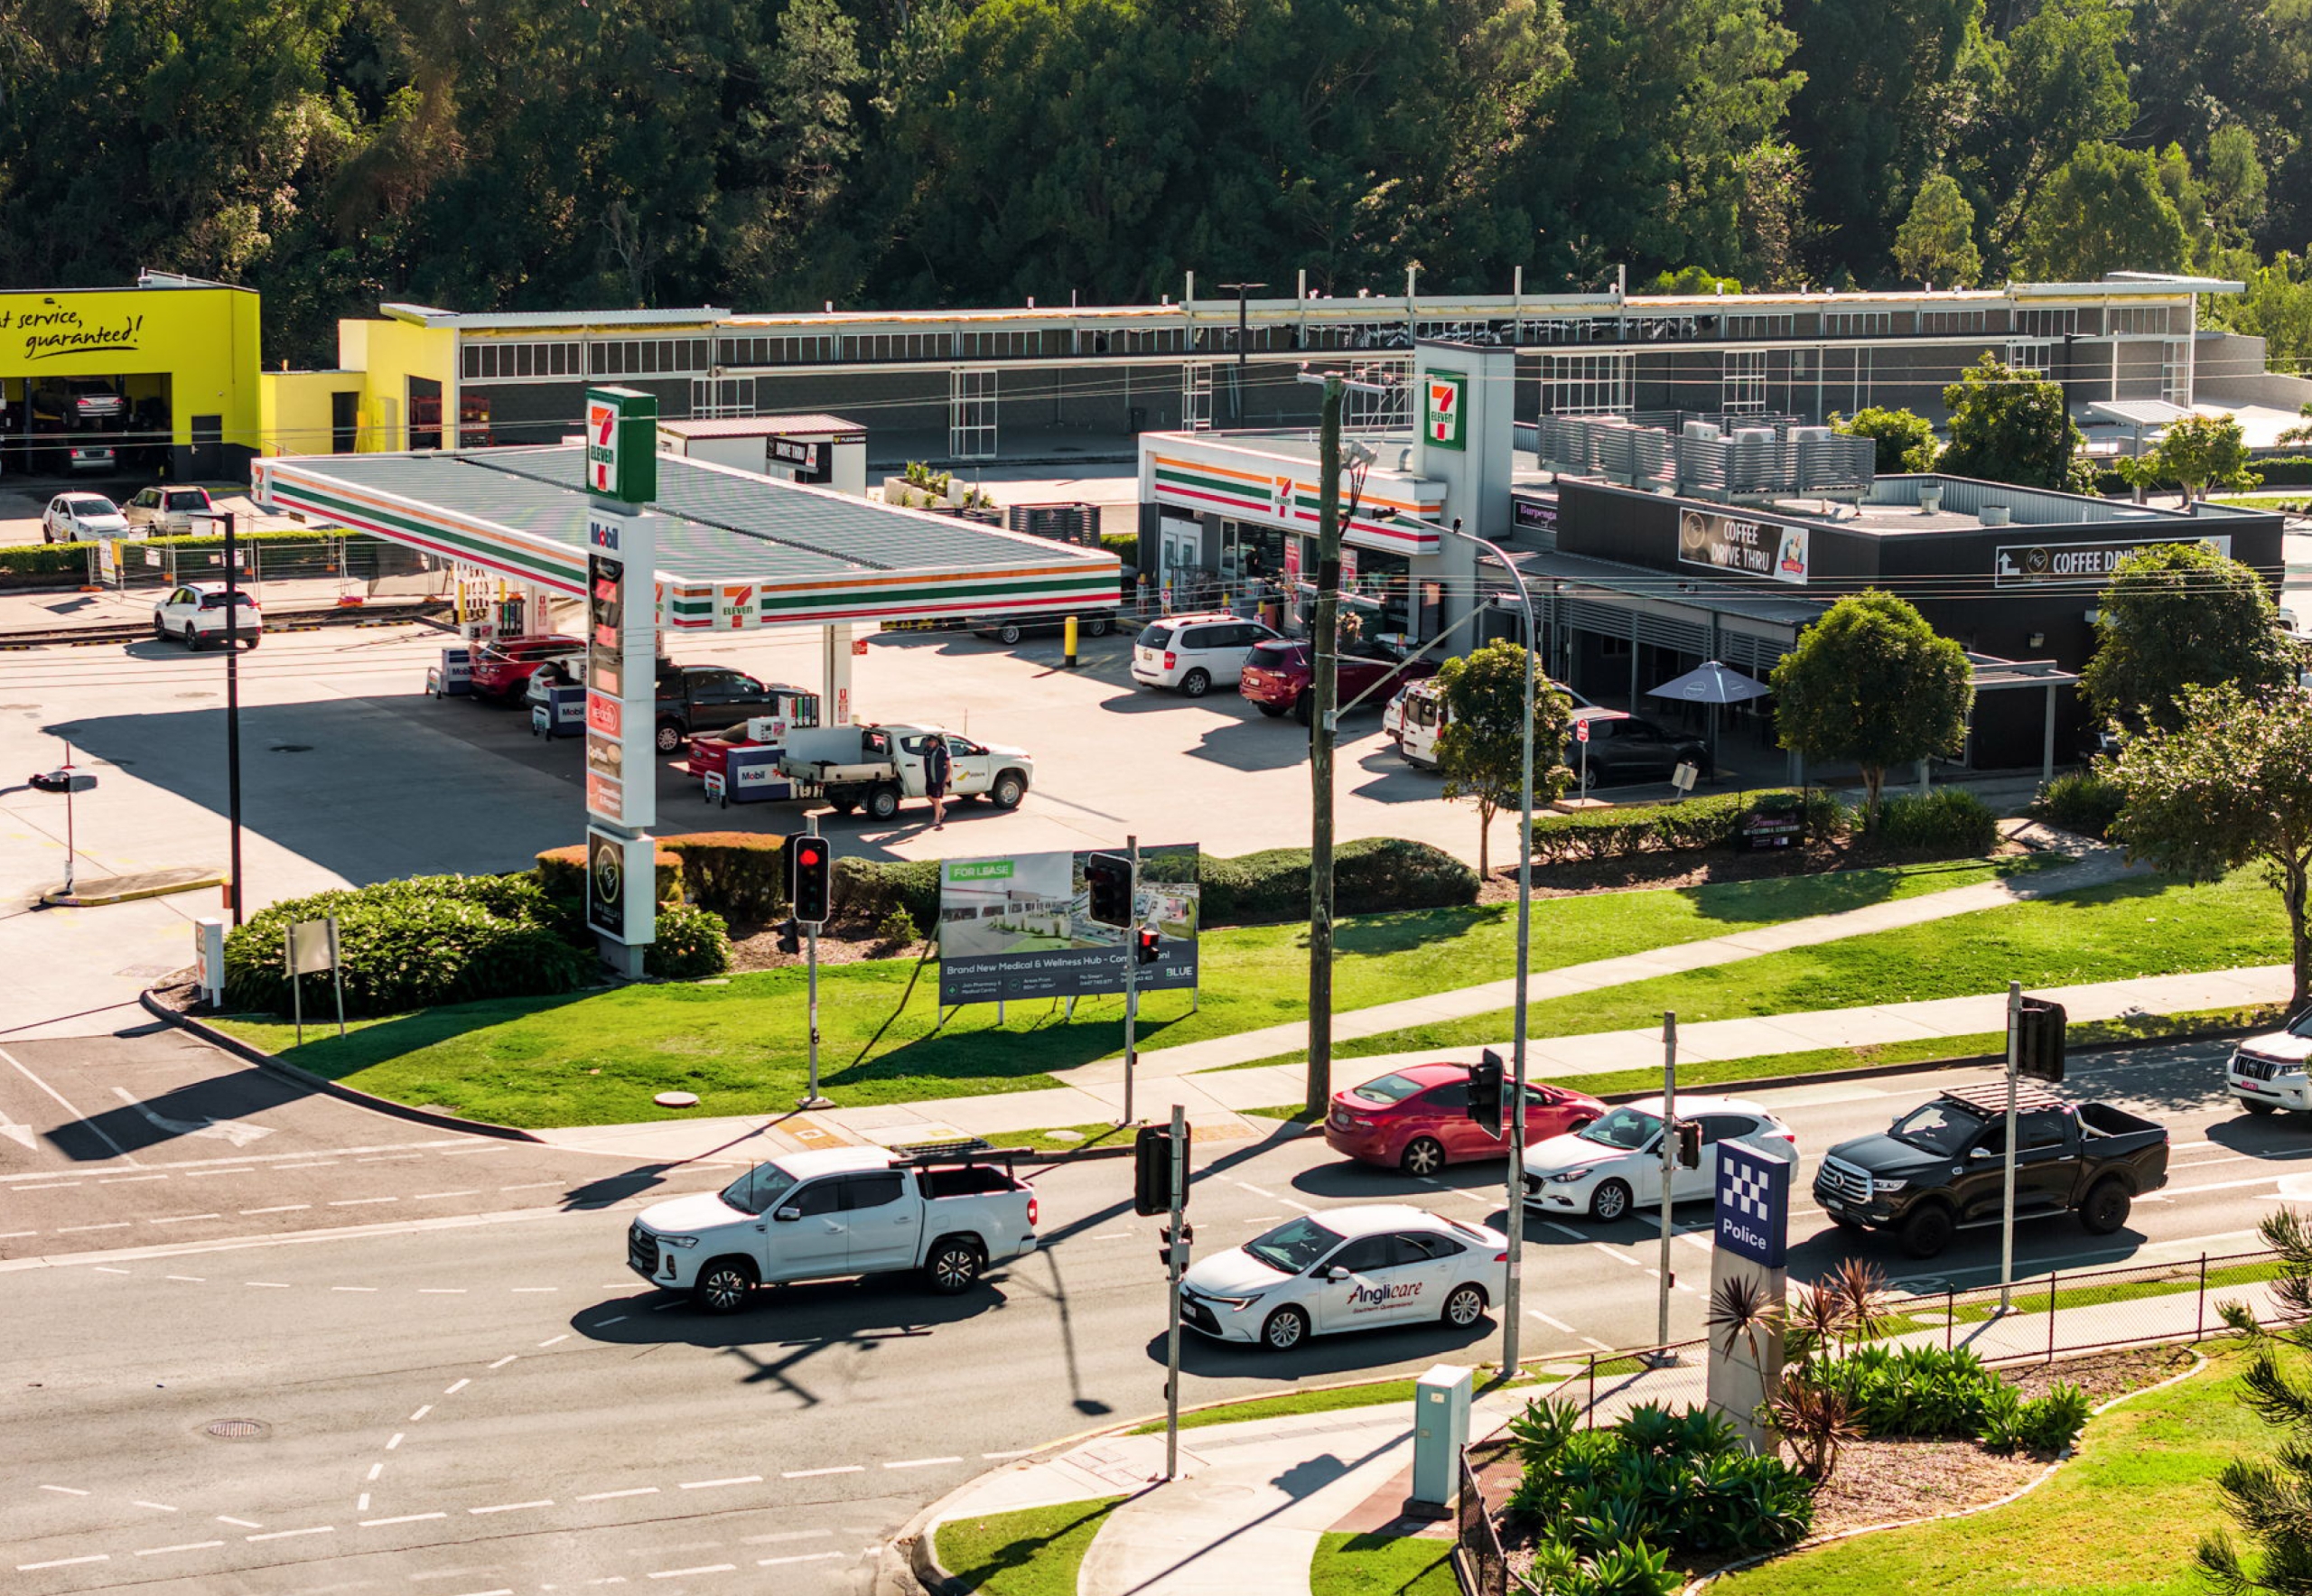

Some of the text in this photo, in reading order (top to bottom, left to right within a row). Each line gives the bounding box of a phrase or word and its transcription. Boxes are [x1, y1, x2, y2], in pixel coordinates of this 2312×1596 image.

[0, 304, 83, 330] t service,
[24, 315, 144, 359] guaranteed!
[591, 522, 619, 550] Mobil
[1724, 521, 1759, 546] COFFEE
[1711, 543, 1741, 567] DRIVE
[1743, 547, 1770, 572] THRU
[2053, 550, 2102, 574] COFFEE
[723, 585, 752, 629] 7
[562, 707, 584, 716] Mobil
[741, 770, 766, 780] Mobil
[954, 864, 1009, 877] FOR LEASE
[946, 965, 974, 975] Brand
[976, 964, 997, 973] New
[998, 960, 1033, 971] Medical
[1034, 959, 1041, 968] &
[1043, 957, 1082, 967] Wellness
[1083, 956, 1102, 966] Hub
[1166, 966, 1193, 977] BLUE
[1722, 1218, 1767, 1250] Police
[1347, 1282, 1422, 1305] Anglicare
